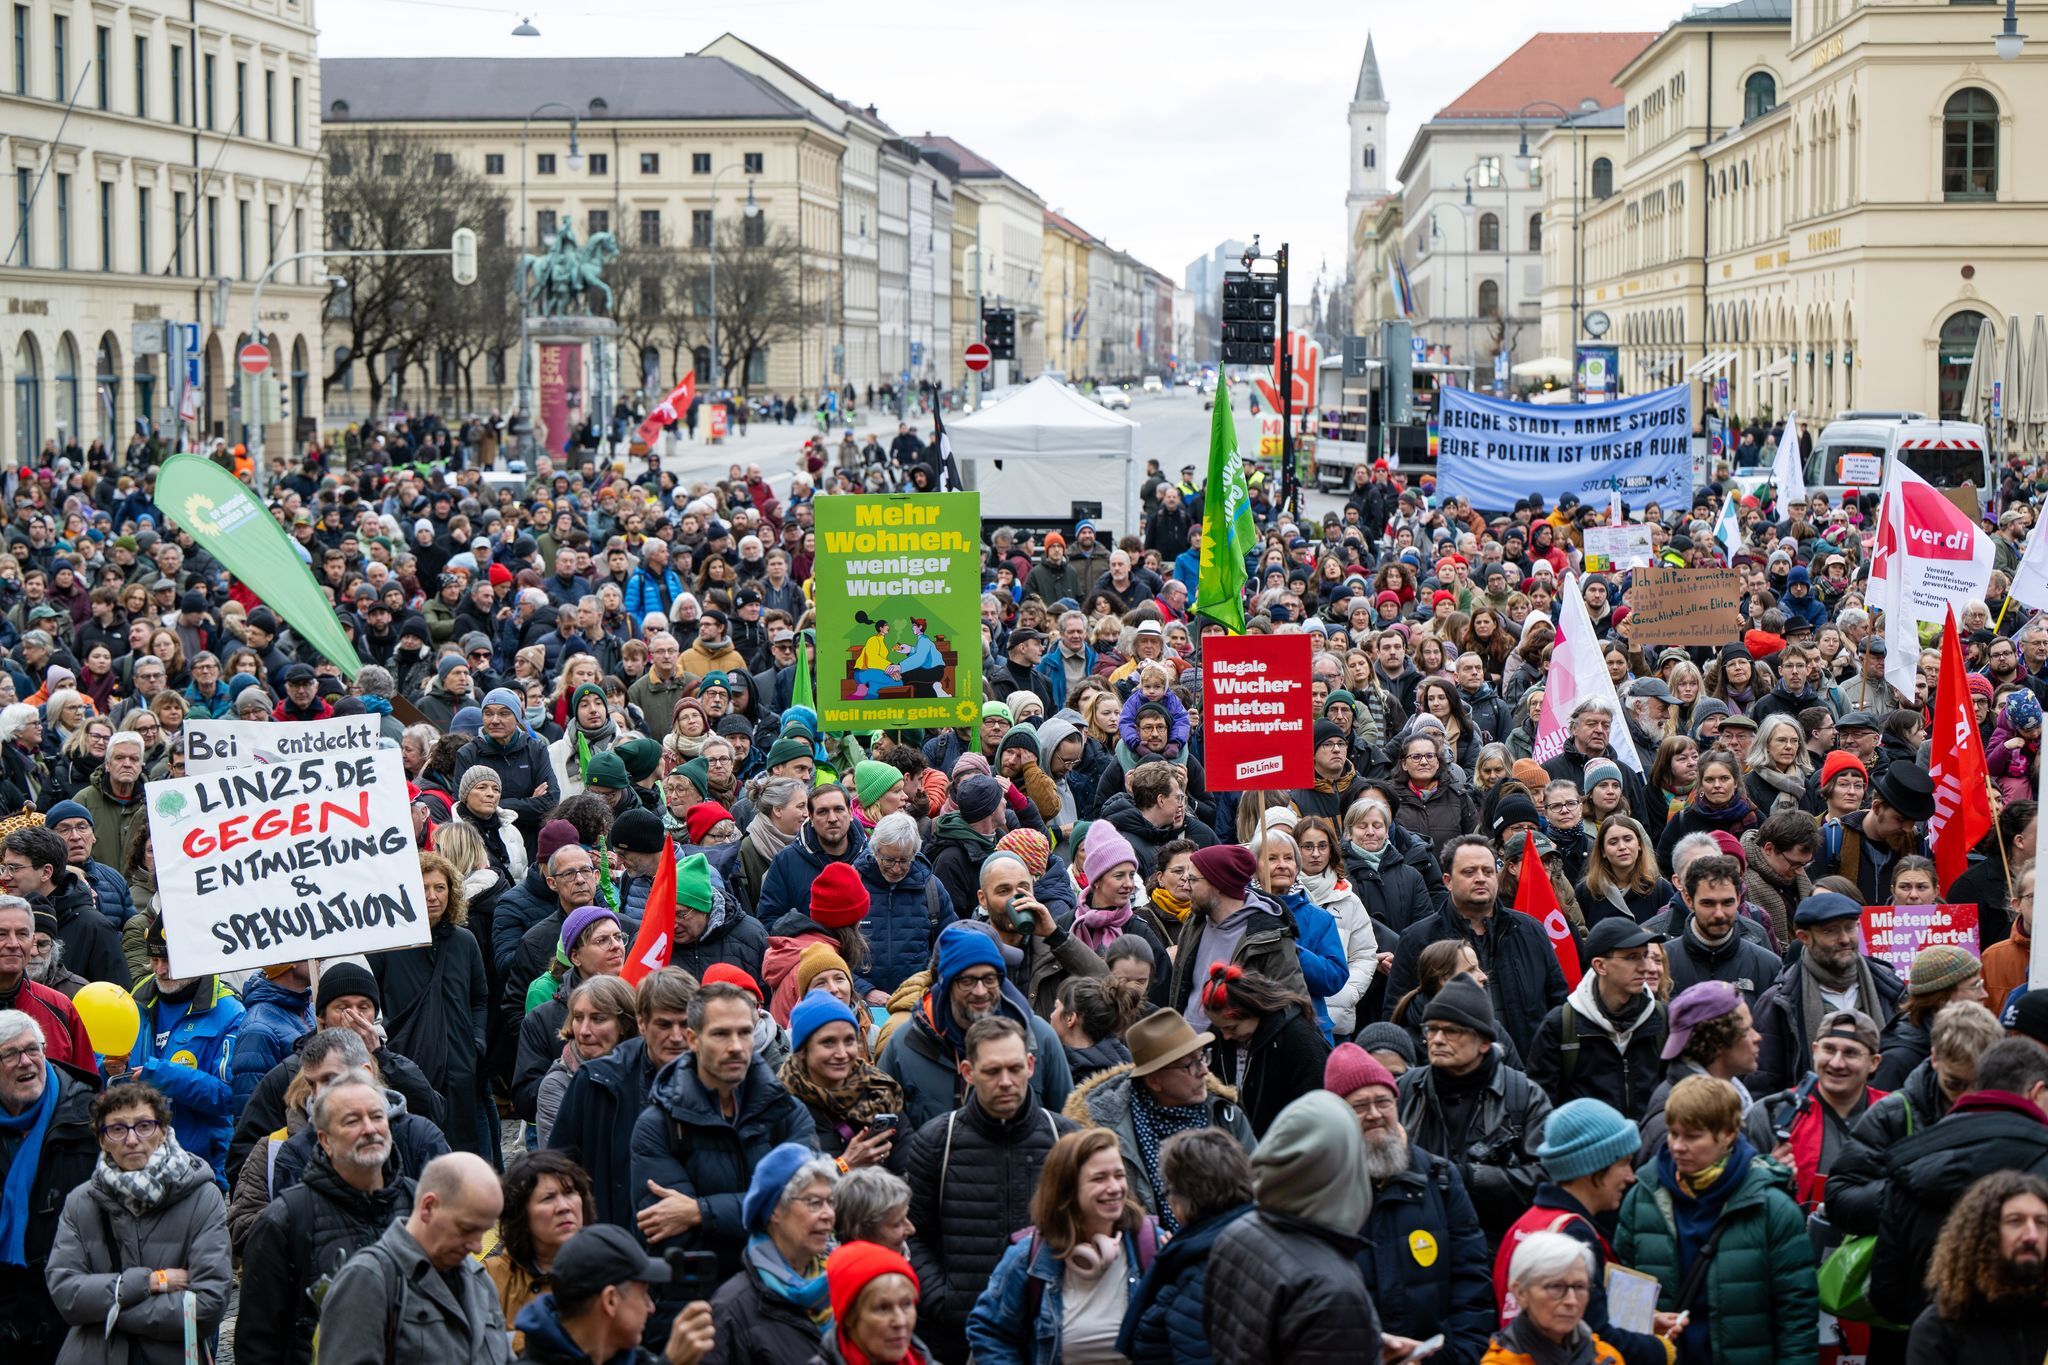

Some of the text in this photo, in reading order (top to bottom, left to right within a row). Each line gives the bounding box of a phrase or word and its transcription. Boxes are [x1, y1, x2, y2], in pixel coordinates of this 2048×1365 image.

[1443, 407, 1686, 436] REICHE STADT, ARME STUDIS
[1440, 436, 1687, 463] EURE POLITIK IST UNSER RUIN
[1581, 479, 1624, 492] STUDS
[855, 503, 940, 526] Mehr
[824, 530, 971, 553] Wohnen,
[1909, 525, 1968, 550] ver.di
[845, 556, 951, 576] weniger
[1926, 566, 1954, 576] Vereinte
[1635, 568, 1651, 587] Ich
[1655, 572, 1669, 584] will
[1922, 580, 1969, 593] gewerkschaft
[1924, 573, 1978, 588] Dienstleistungs-
[845, 578, 952, 596] Wucher.
[1913, 598, 1940, 608] ünchen
[1212, 660, 1267, 676] Illegale
[1212, 677, 1302, 694] Wucher-
[824, 706, 951, 722] Weil mehr geht.
[1213, 699, 1285, 716] mieten
[1213, 718, 1303, 734] bekämpfen!
[188, 731, 237, 760] Bei
[1240, 761, 1280, 775] Die Linke
[194, 756, 377, 813] LIN25.DE
[182, 791, 370, 858] GEGEN
[194, 826, 408, 896] ENTMIETUNG
[290, 875, 322, 897] &
[211, 884, 417, 955] SPEKULATION
[1870, 911, 1952, 928] Mietende
[1871, 927, 1974, 945] aller Viertel
[1872, 947, 1918, 963] verei
